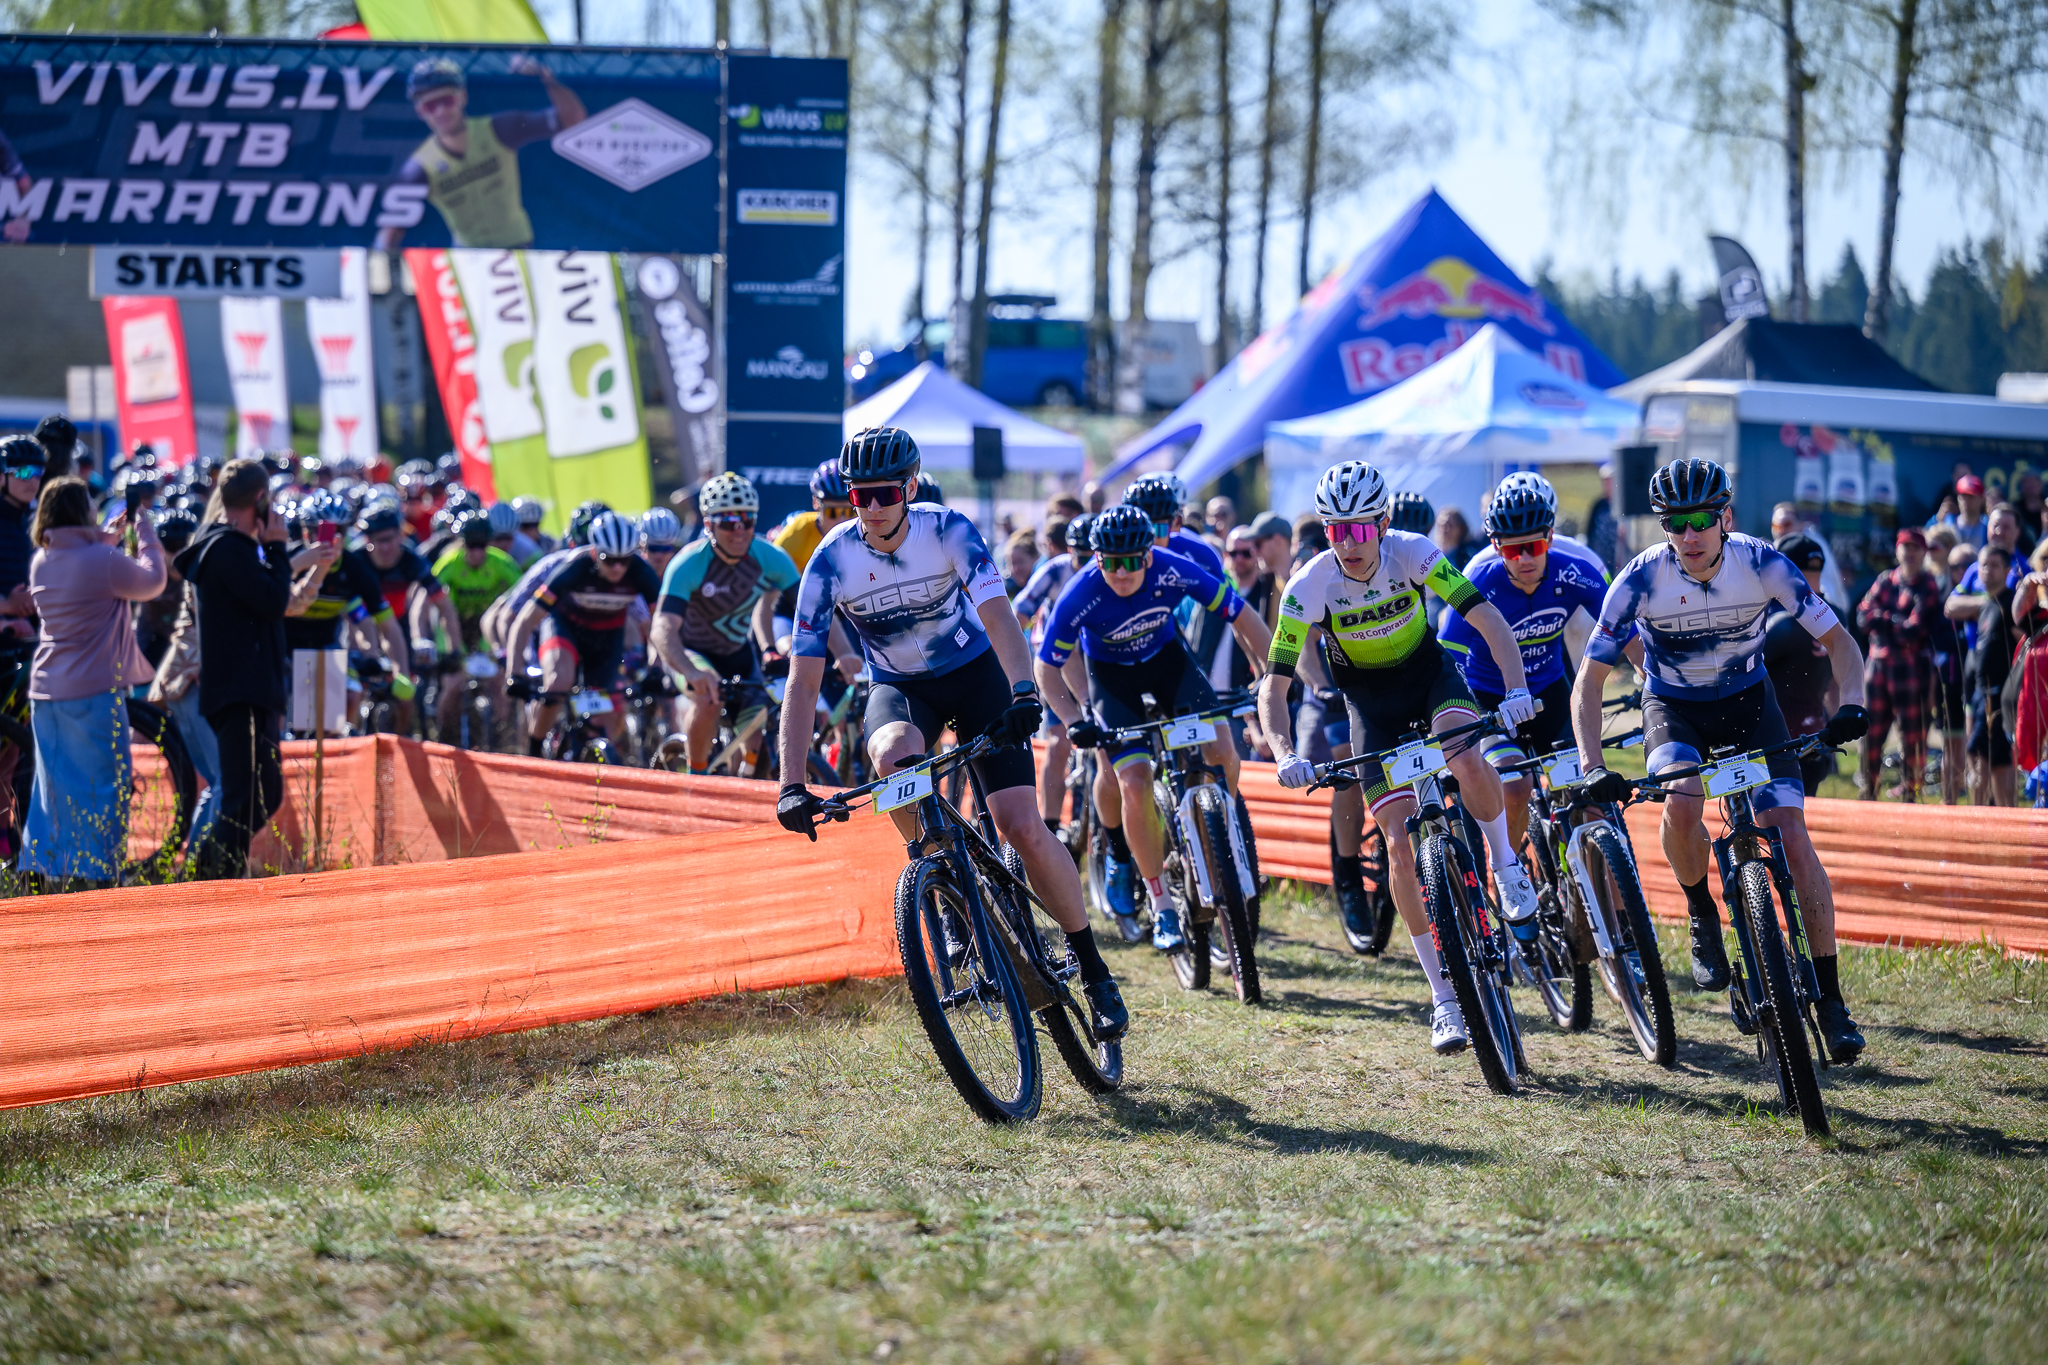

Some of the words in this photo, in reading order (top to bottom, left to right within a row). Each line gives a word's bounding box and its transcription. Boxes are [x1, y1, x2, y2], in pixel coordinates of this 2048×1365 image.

[32, 60, 397, 110] VIVUS.LV
[128, 120, 291, 167] MTB
[0, 178, 429, 228] MARATONS
[116, 254, 304, 288] STARTS
[1577, 576, 1600, 588] GROUP
[847, 574, 953, 616] OGRE
[1338, 595, 1412, 629] DAKO
[1366, 612, 1414, 637] Corporation
[1651, 606, 1763, 632] OGRE
[1187, 728, 1197, 740] 3
[1413, 755, 1424, 770] 4
[1573, 763, 1580, 777] 1
[1734, 769, 1746, 785] 5
[897, 781, 916, 801] 10
